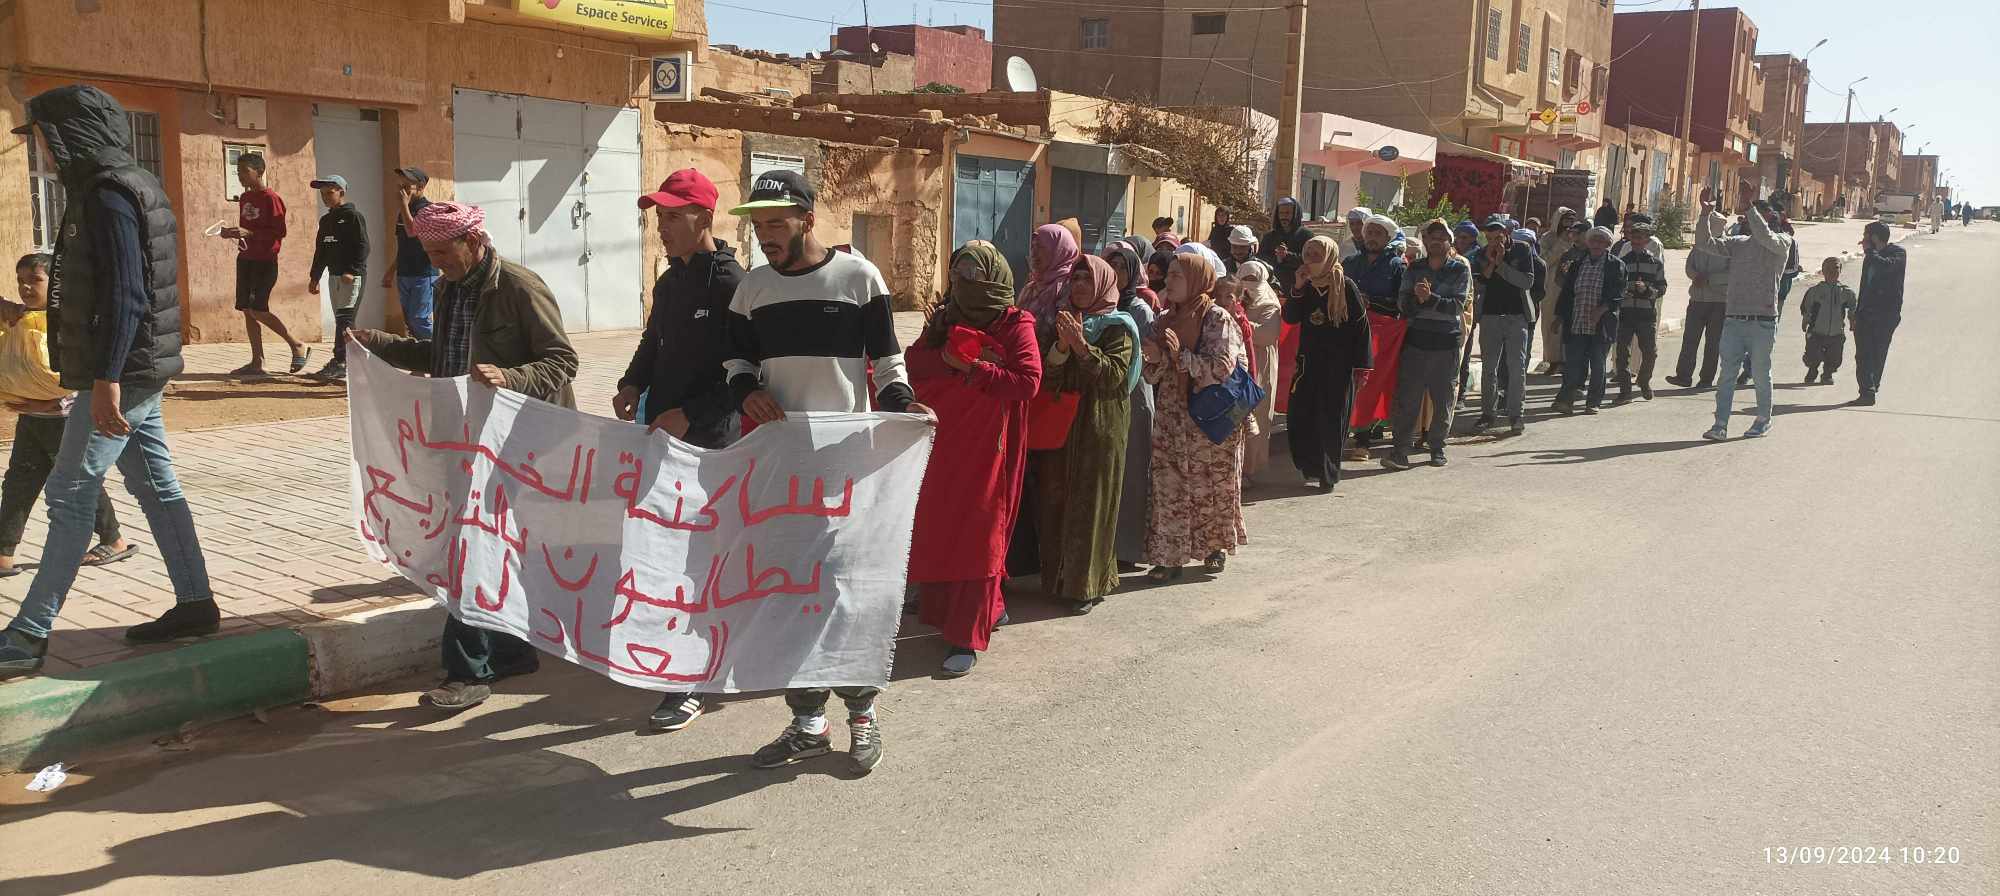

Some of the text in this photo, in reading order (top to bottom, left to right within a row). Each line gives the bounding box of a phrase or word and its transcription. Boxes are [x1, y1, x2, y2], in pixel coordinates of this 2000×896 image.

[576, 3, 618, 21] Espace
[621, 12, 668, 29] Services
[397, 399, 854, 532] ساكنة الخيام
[535, 543, 823, 631] يطالبون
